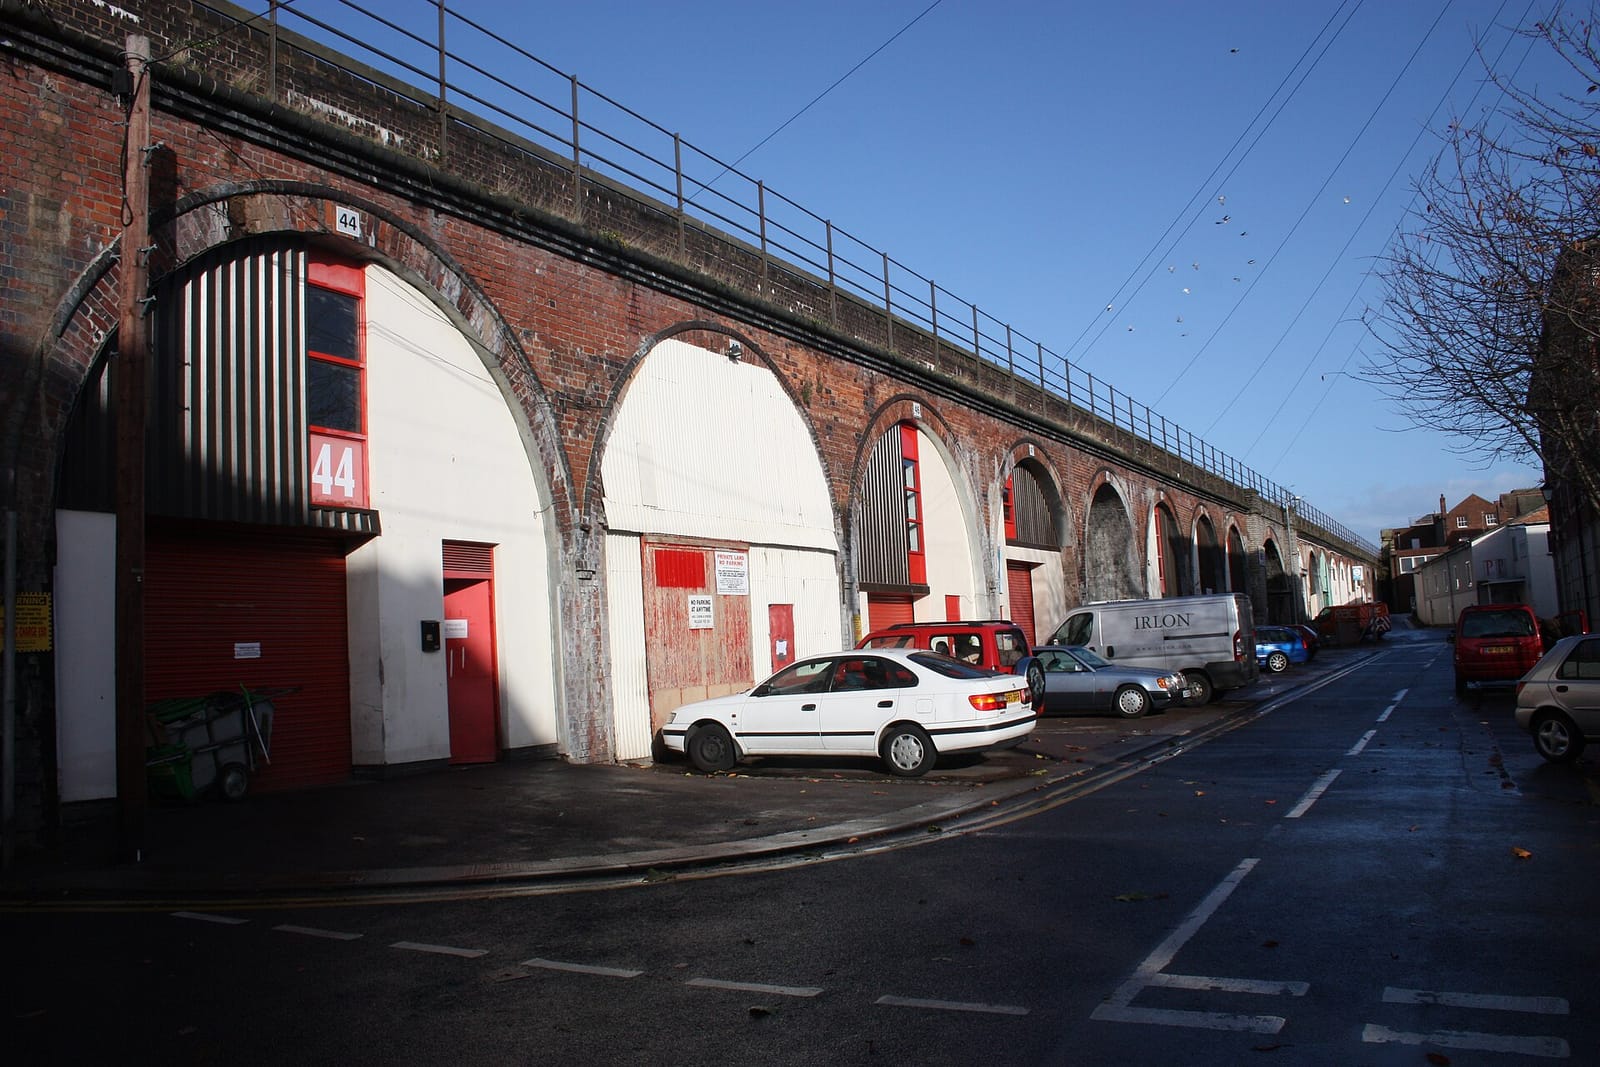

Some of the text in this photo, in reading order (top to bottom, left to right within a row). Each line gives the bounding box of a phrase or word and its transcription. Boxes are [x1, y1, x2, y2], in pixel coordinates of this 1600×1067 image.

[339, 213, 357, 231] 44
[311, 443, 355, 498] 44
[1134, 613, 1190, 630] IRLON
